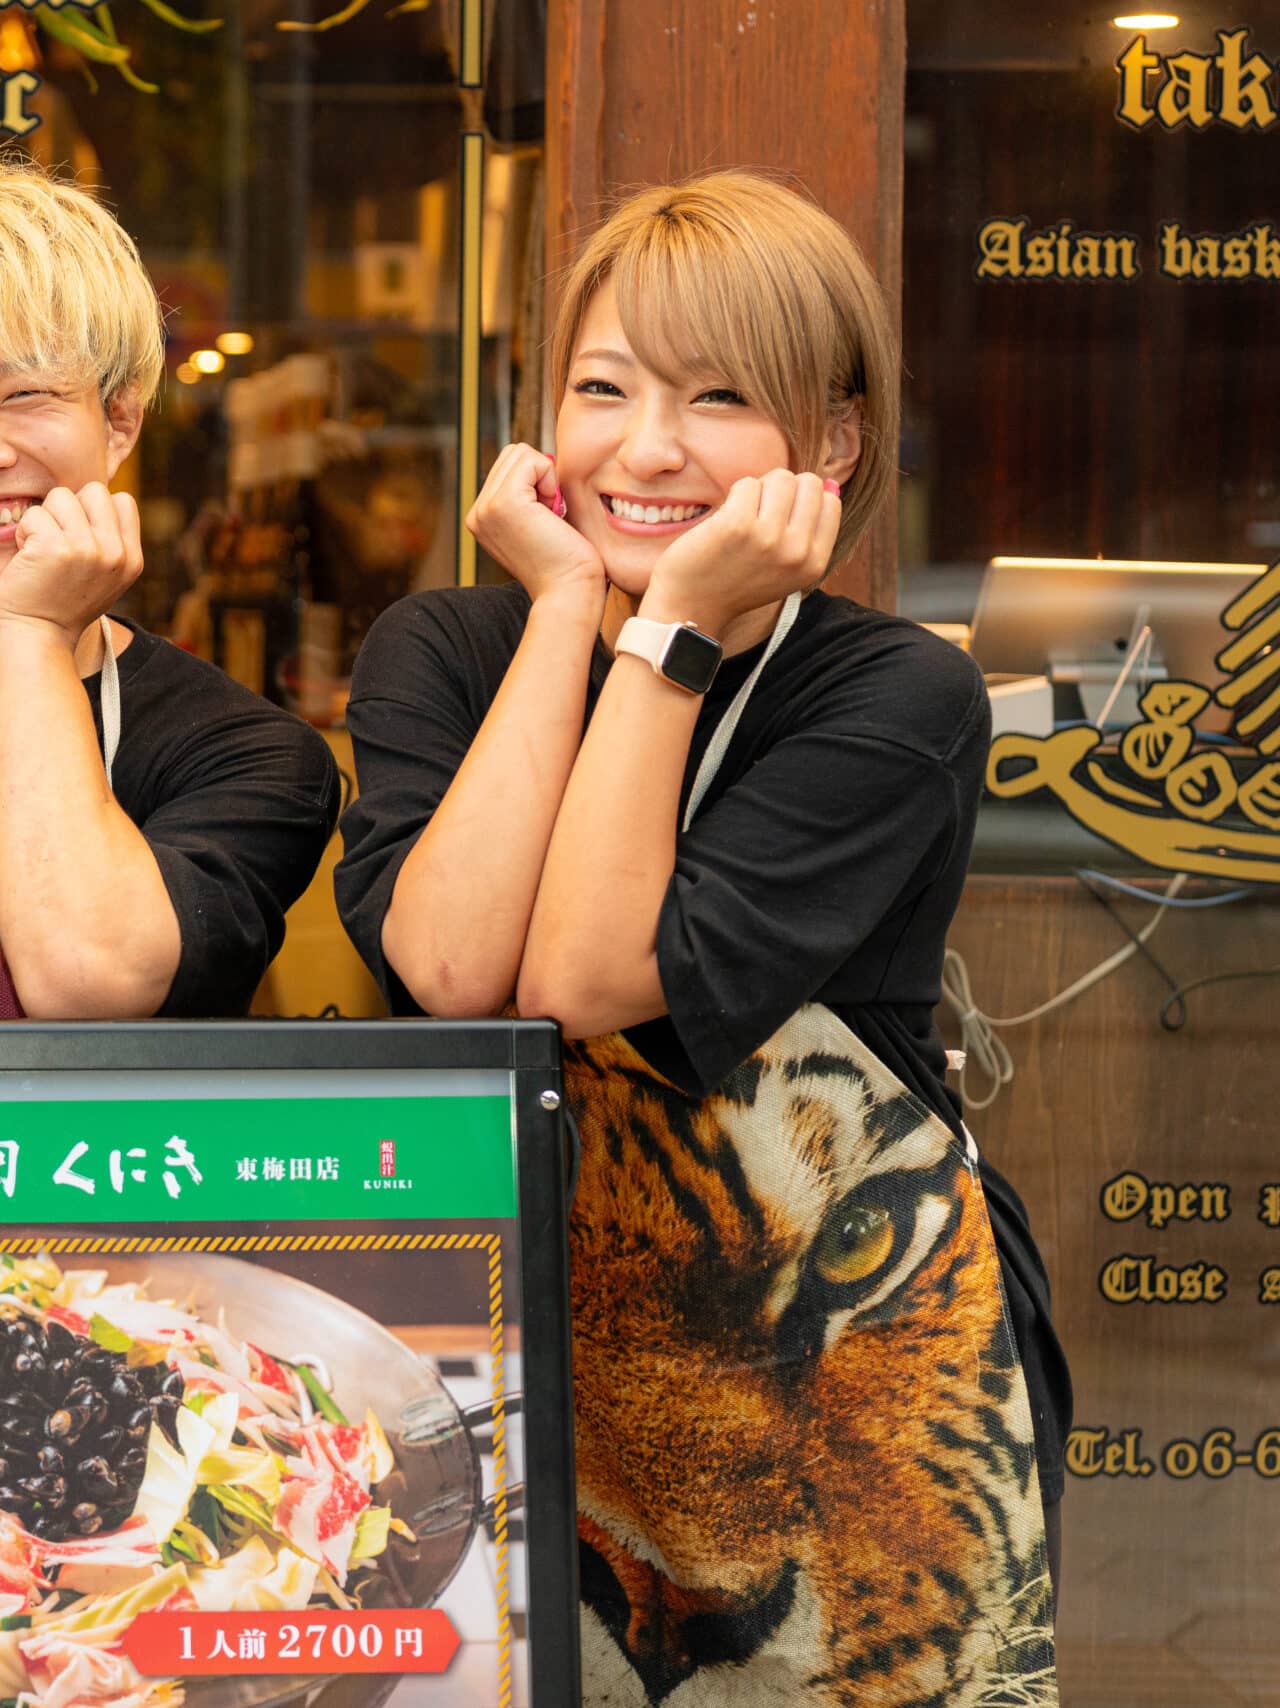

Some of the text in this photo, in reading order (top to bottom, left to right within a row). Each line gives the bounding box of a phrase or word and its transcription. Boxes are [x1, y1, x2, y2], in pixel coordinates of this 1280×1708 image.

[976, 219, 1139, 279] Asian
[52, 1134, 204, 1199] くにき
[234, 1156, 340, 1182] 東梅田店
[363, 1179, 413, 1190] KUNIKI
[1102, 1172, 1229, 1228] Open
[1100, 1255, 1227, 1303] Close
[1065, 1429, 1153, 1476] Tel.
